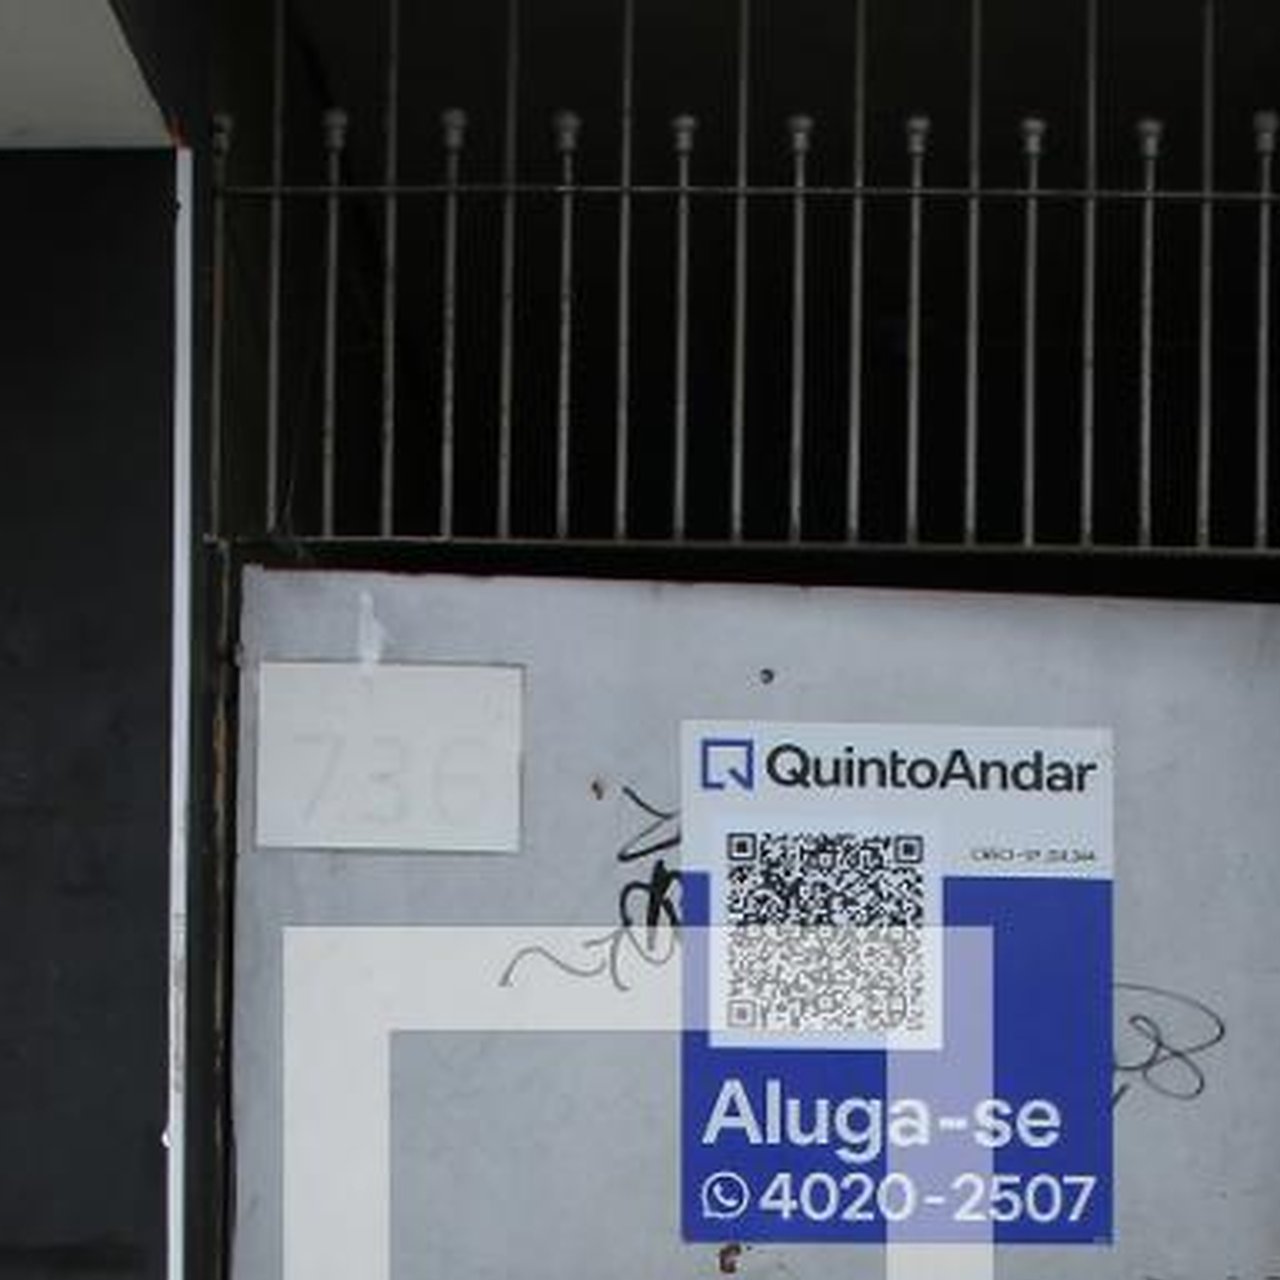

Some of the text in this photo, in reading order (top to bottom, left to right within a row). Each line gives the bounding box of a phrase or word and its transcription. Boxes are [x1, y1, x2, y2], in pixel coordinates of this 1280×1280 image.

[764, 742, 1099, 793] QuintoAndar
[701, 1078, 1062, 1164] Aluga-se
[758, 1171, 1098, 1222] 4020-2507
